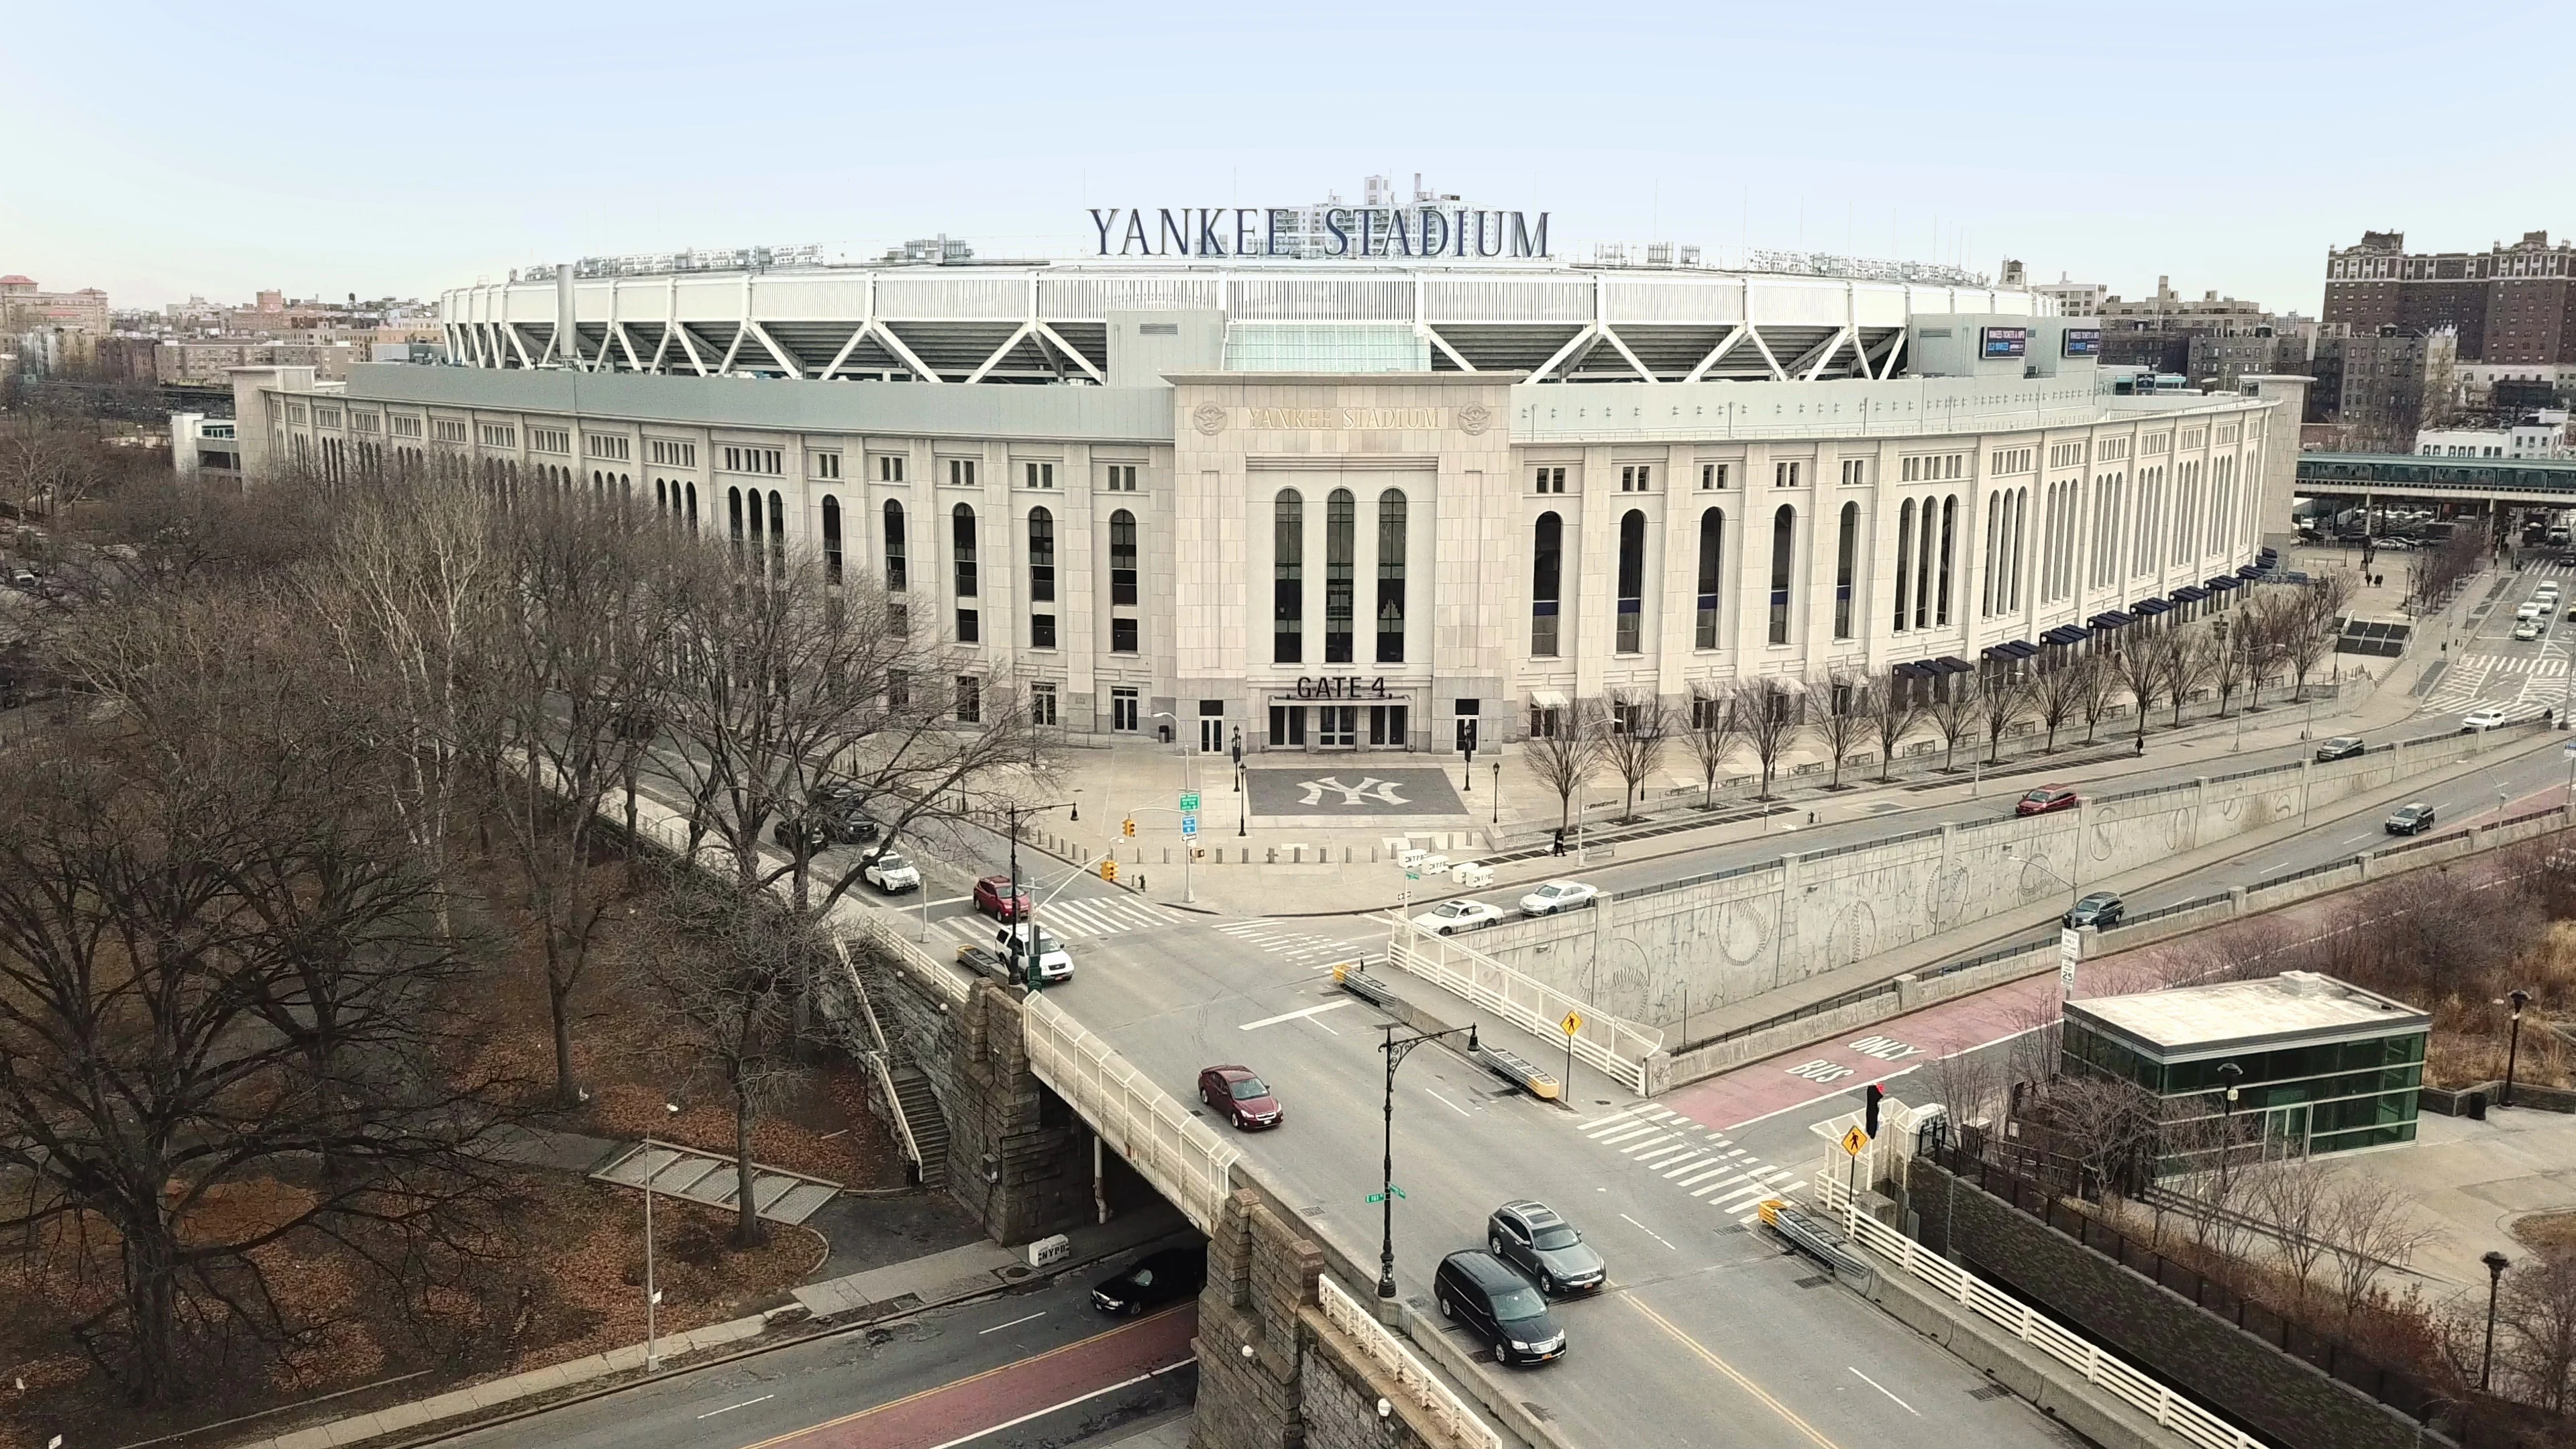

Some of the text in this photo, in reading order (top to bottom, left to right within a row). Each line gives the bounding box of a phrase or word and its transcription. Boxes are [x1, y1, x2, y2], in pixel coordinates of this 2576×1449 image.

[1085, 209, 1552, 258] YANKEE STADIUM
[1248, 407, 1440, 429] YANKEE STADIUM
[1297, 677, 1385, 698] GATE 4
[1295, 776, 1413, 805] NY
[2062, 971, 2073, 981] 25
[1848, 1035, 1926, 1061] ONLY
[1784, 1059, 1854, 1083] BUS
[1042, 1244, 1065, 1260] NYPD
